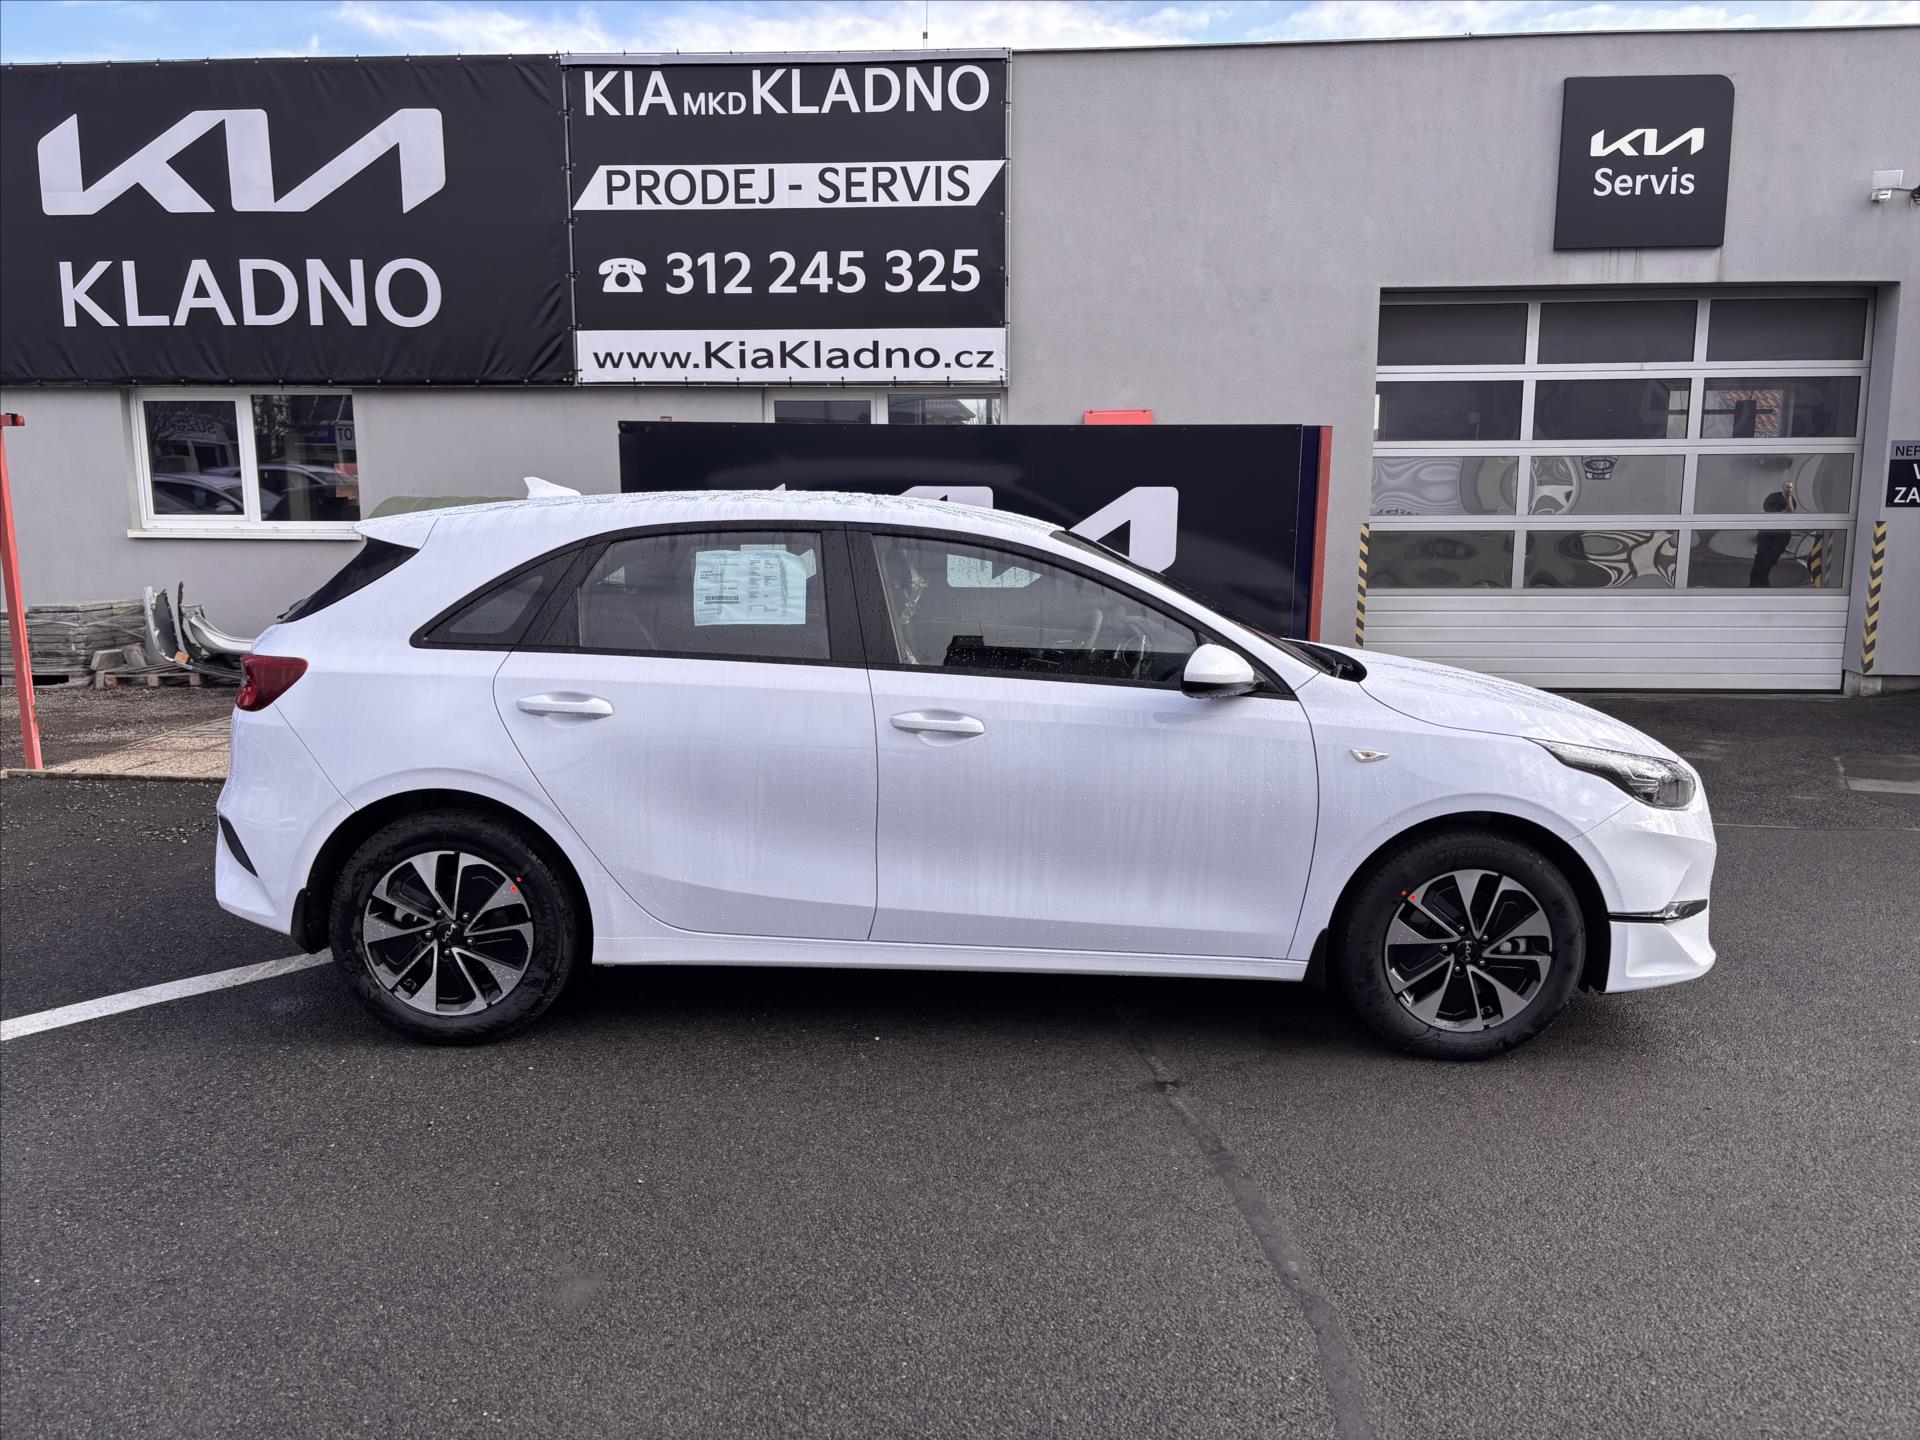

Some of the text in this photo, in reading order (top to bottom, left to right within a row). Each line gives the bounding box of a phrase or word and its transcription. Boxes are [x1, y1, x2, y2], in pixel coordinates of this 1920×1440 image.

[585, 65, 990, 116] KIA MKD KLADNO
[37, 107, 446, 216] KIA
[1589, 127, 1706, 157] KIA
[606, 168, 776, 206] PRODEJ
[818, 164, 971, 204] SERVIS
[1593, 166, 1695, 197] Servis
[58, 257, 442, 328] KLADNO
[666, 248, 981, 295] 312 245 325
[592, 340, 994, 370] www.KiaKladno.cz
[1893, 486, 1920, 504] ZA
